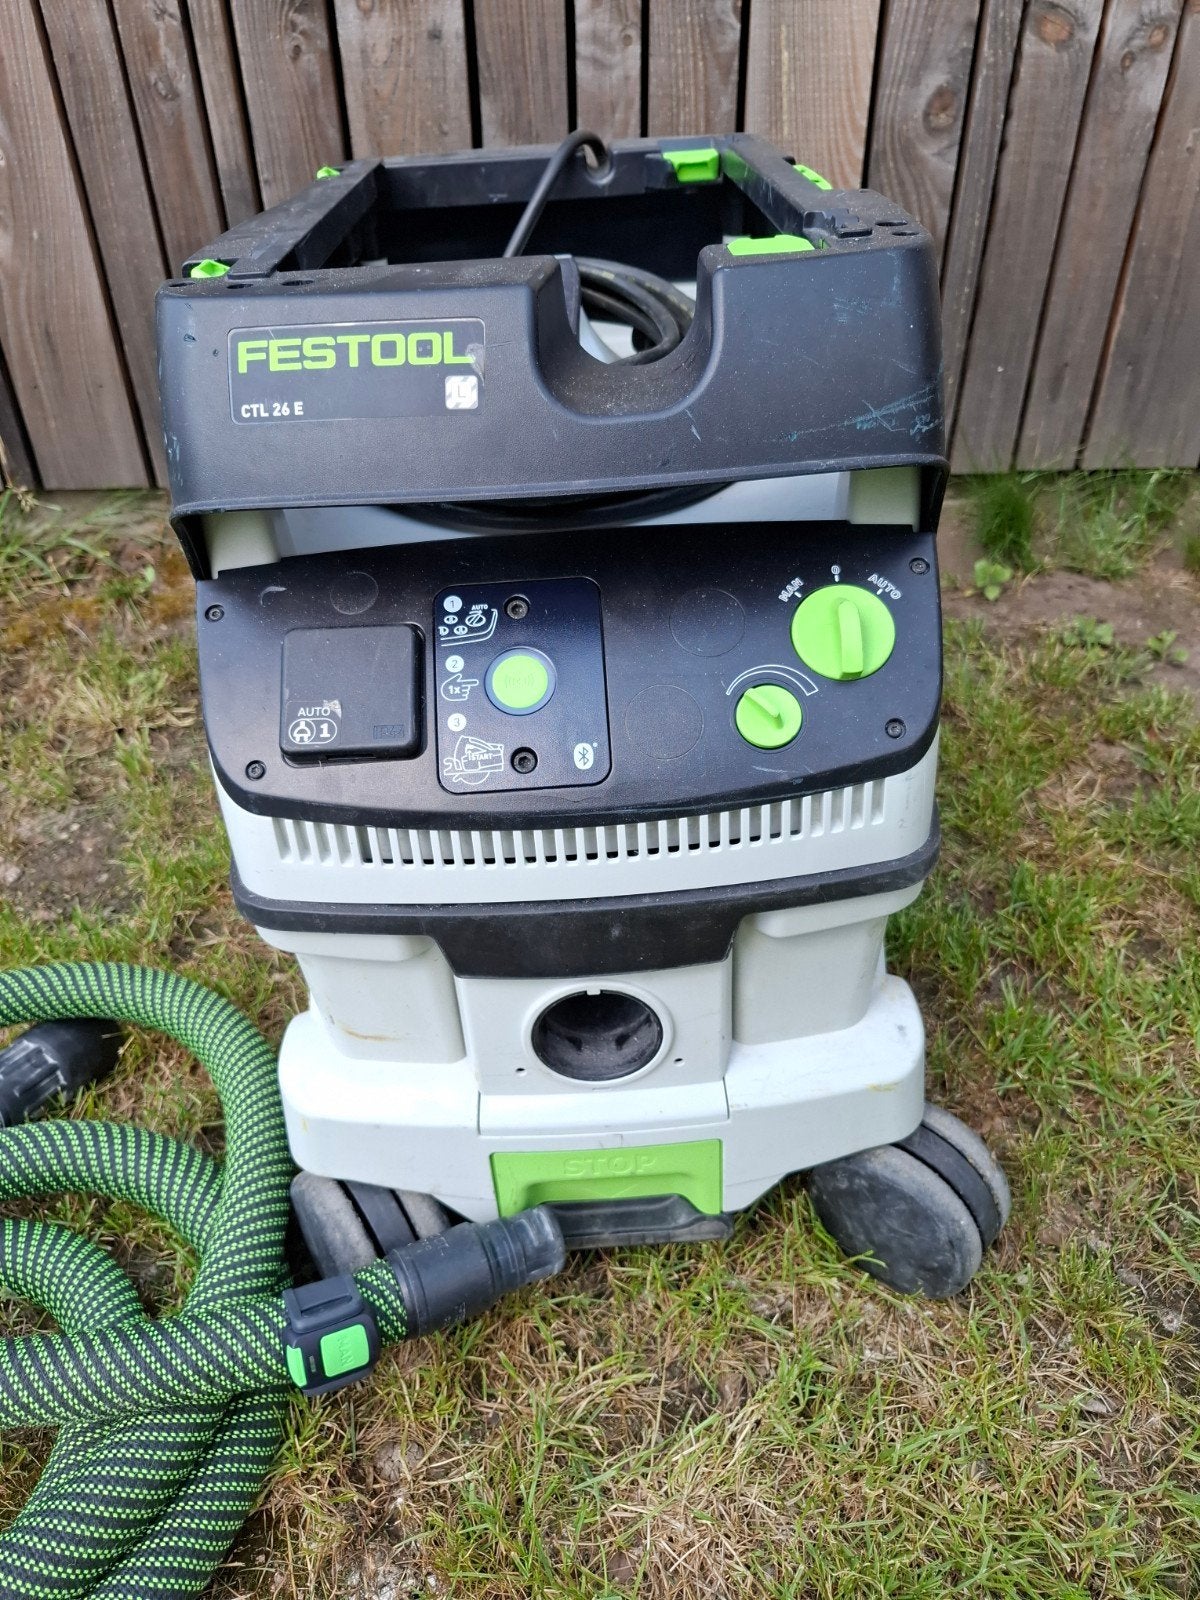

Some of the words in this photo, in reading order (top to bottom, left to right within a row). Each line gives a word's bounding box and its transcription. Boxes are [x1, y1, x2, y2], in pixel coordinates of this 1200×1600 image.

[237, 332, 475, 374] FESTOOL
[241, 405, 269, 418] CTL
[273, 402, 290, 416] 26
[294, 401, 304, 416] E
[778, 577, 804, 602] MAN
[867, 573, 902, 600] AUTO
[448, 685, 461, 695] 1x
[297, 706, 331, 717] AUTO
[319, 723, 331, 738] 1
[472, 752, 493, 761] START
[563, 1154, 657, 1176] STOP
